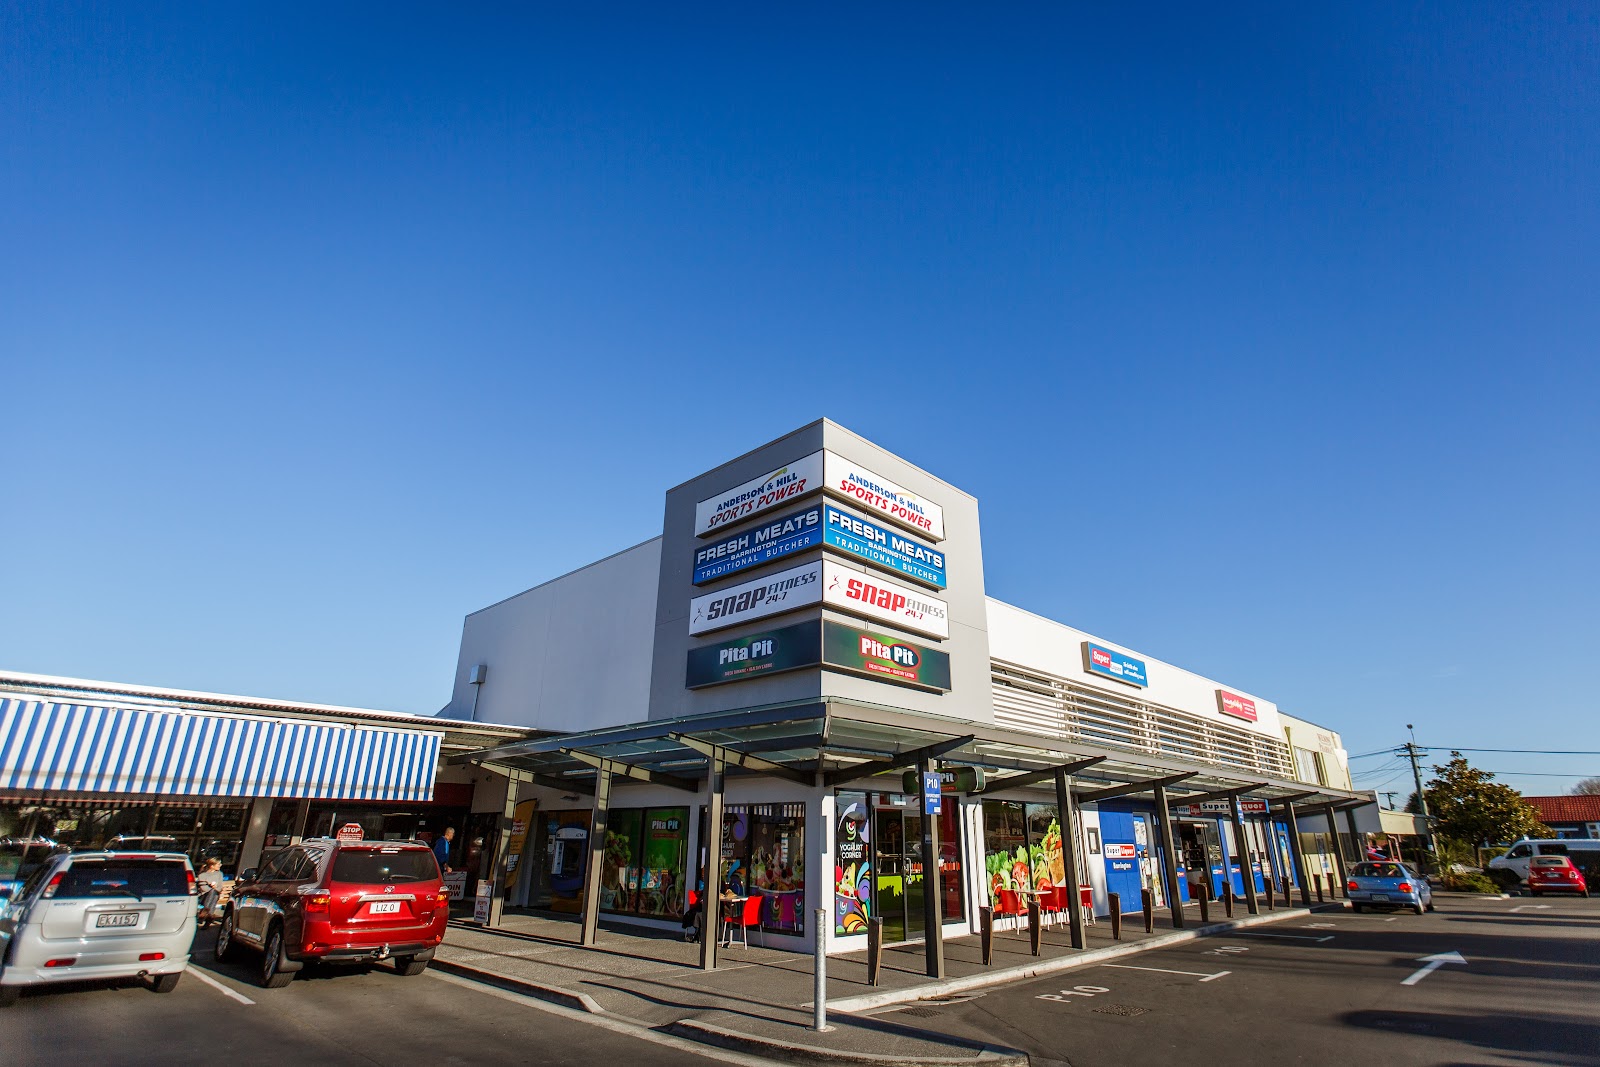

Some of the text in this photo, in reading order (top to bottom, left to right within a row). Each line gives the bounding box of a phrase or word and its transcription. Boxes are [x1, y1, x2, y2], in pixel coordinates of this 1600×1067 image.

[717, 472, 797, 512] ANDERSON & HILL
[849, 472, 924, 515] ANDERSON & HILL
[708, 478, 806, 528] SPORTS POWER
[840, 480, 932, 532] SPORTS POWER
[697, 510, 819, 565] FRESH MEATS
[828, 509, 943, 568] FRESH MEATS
[701, 537, 810, 579] TRADITIONAL BUTCHER
[730, 540, 777, 561] BARRINGTON
[835, 536, 938, 582] TRADITIONAL BUTCHER
[868, 541, 912, 564] BARRINGTON
[767, 571, 818, 595] FITNESS
[765, 591, 788, 605] 24-7
[907, 598, 945, 619] FITNESS
[905, 609, 924, 620] 24-7
[719, 640, 773, 665] Pita Pit
[862, 637, 914, 666] Pita Pit
[1093, 651, 1109, 664] Super
[926, 778, 938, 789] P10
[941, 772, 955, 783] Pit
[1202, 803, 1230, 811] Super
[1242, 803, 1263, 811] quor
[652, 820, 679, 830] Pita Pit
[840, 843, 863, 852] YOGHURT
[842, 851, 862, 859] CORNER
[375, 904, 388, 912] LIZ
[98, 914, 138, 927] EKA157
[1034, 985, 1110, 1003] P10
